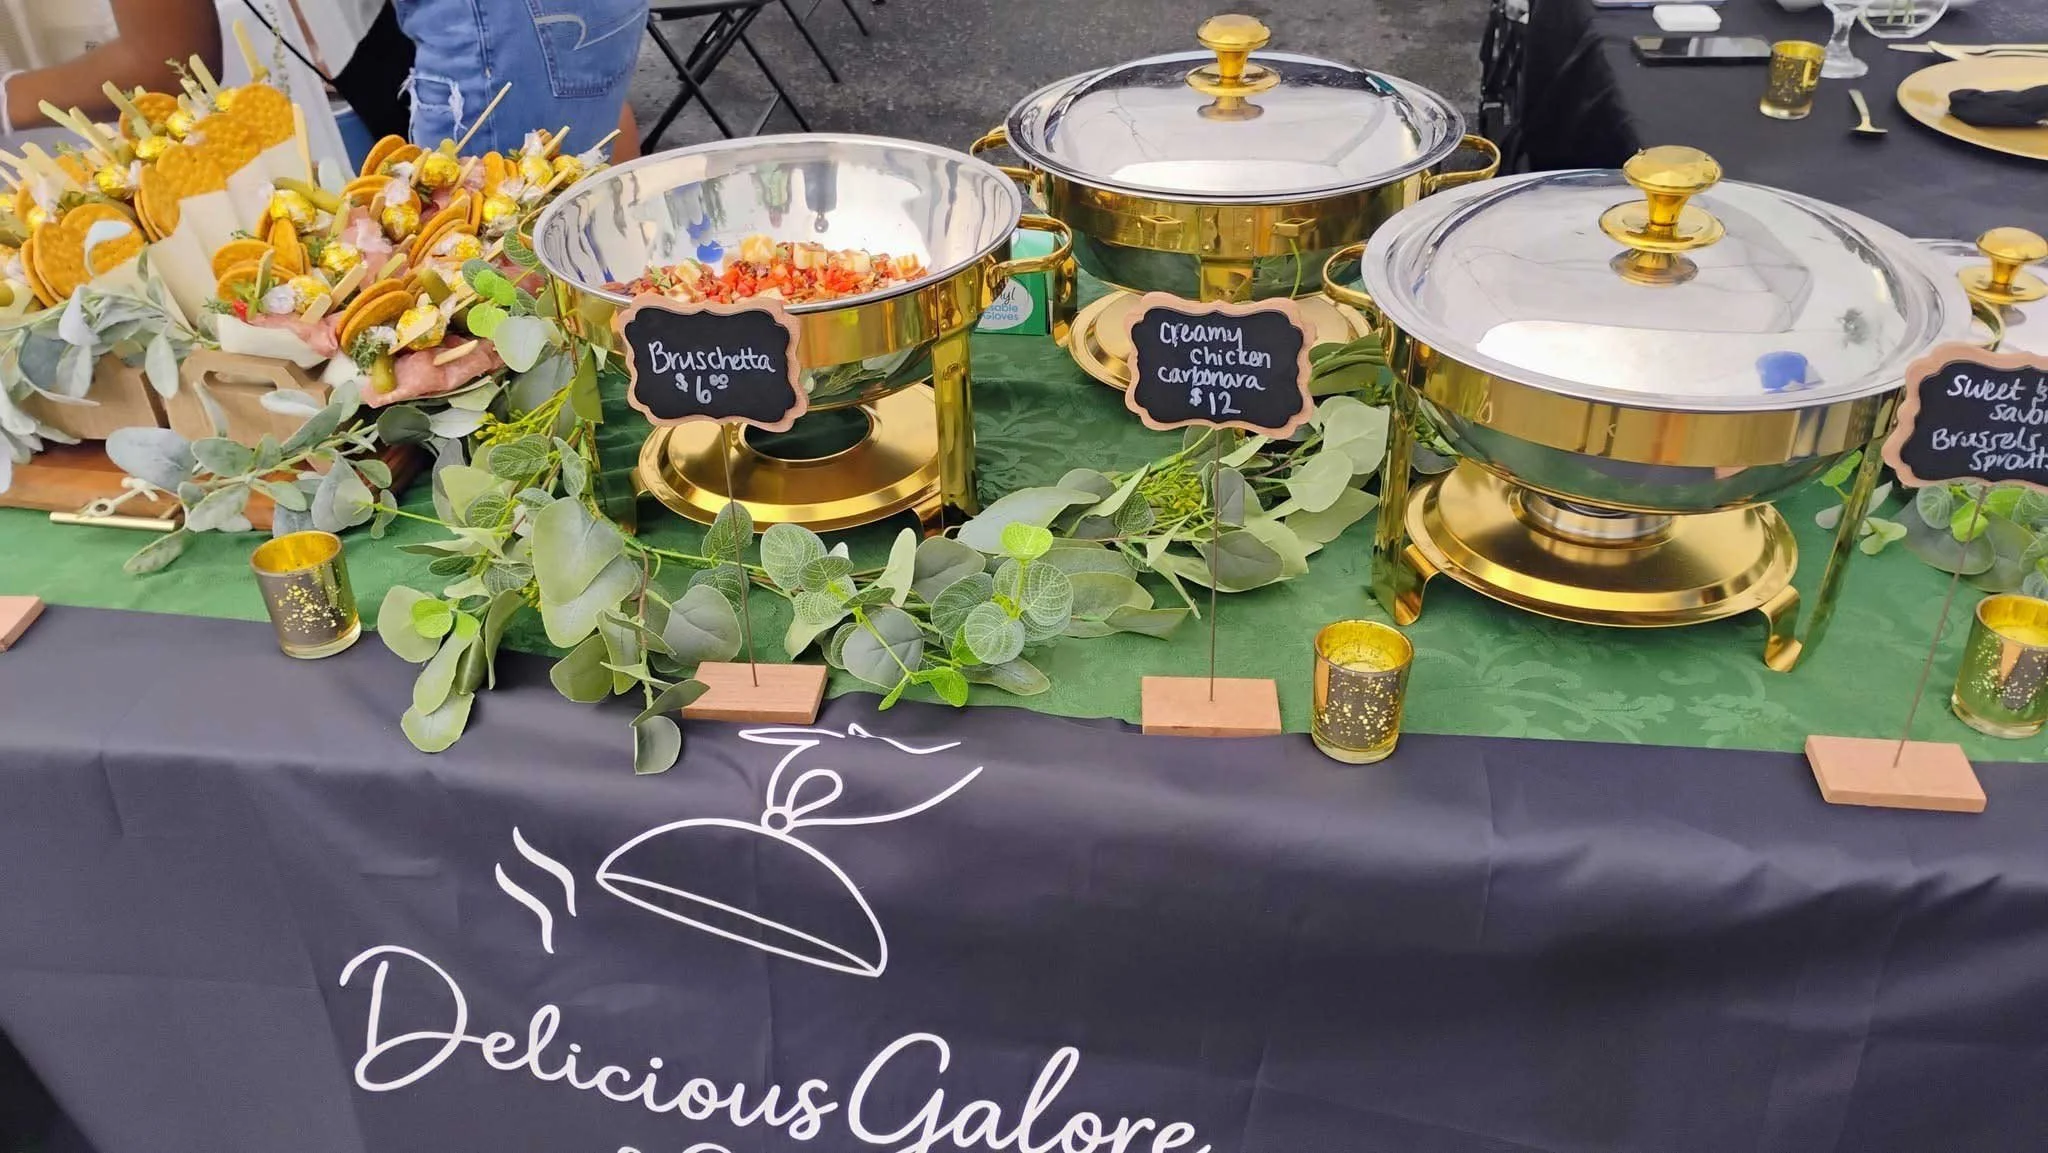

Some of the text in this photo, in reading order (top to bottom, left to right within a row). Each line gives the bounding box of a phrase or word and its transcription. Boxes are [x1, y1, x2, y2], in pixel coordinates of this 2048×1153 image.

[983, 311, 1019, 321] Gloves
[648, 340, 776, 374] Bruschetta
[1946, 374, 2026, 401] Sweet
[1932, 427, 2042, 452] Brussels
[340, 945, 1212, 1153] Delicious Galore
